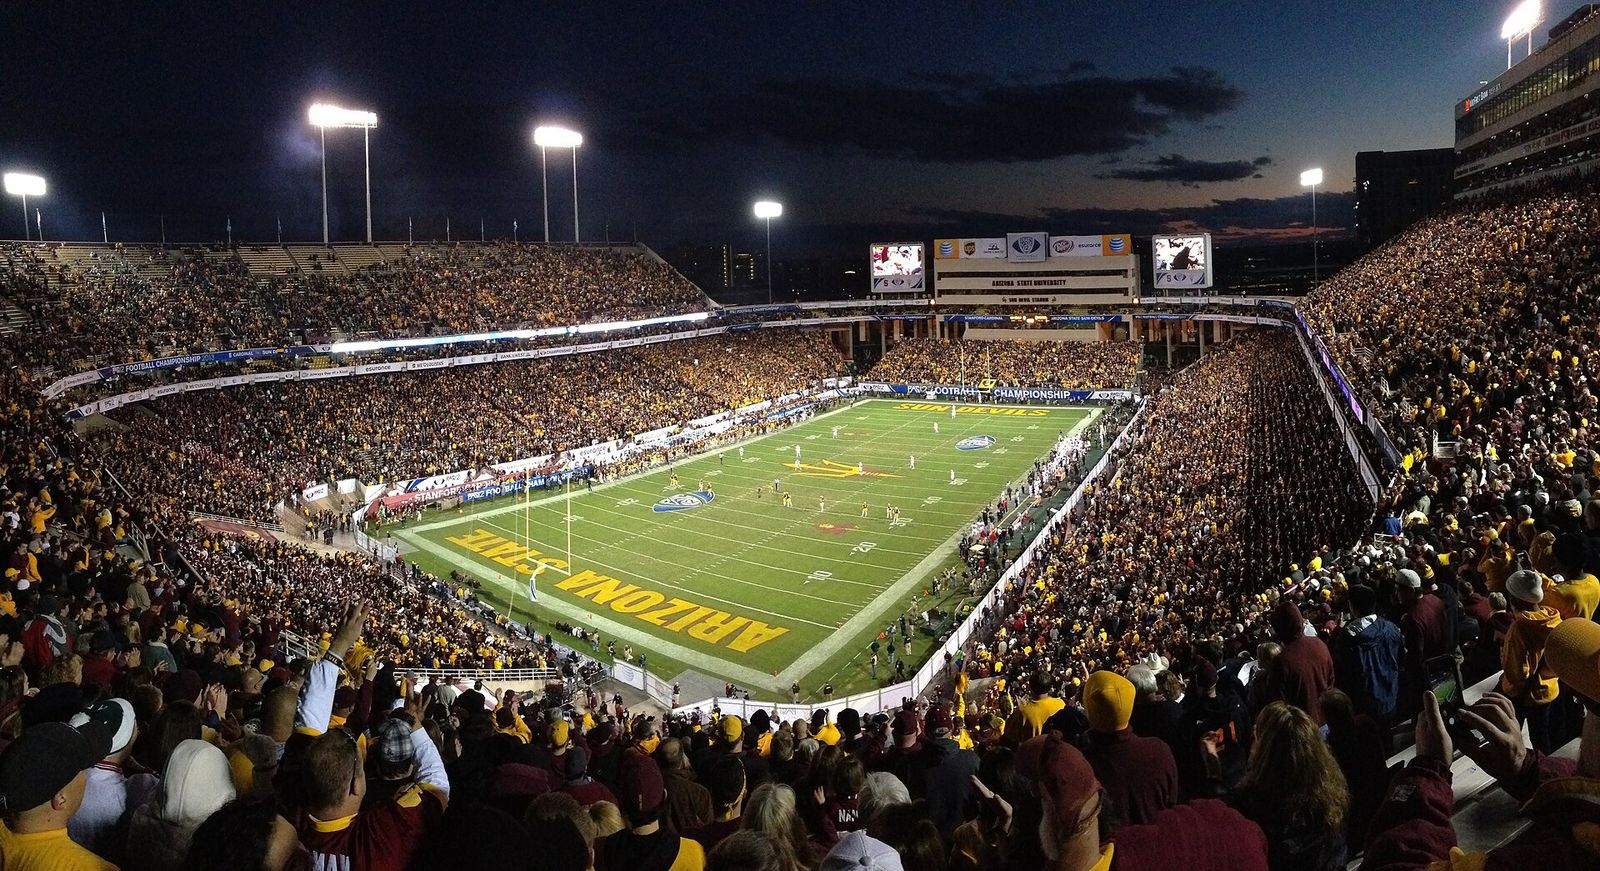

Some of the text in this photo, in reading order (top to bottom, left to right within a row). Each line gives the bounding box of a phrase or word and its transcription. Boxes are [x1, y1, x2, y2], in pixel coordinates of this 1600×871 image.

[125, 362, 155, 372] FOOTBALL
[156, 355, 201, 367] CHAMPIONSHIP
[365, 365, 391, 373] esurance
[993, 388, 1071, 399] CHAMPIONSHIP
[893, 402, 1051, 417] SUN DEVILS
[445, 528, 790, 653] ARIZONA STATE
